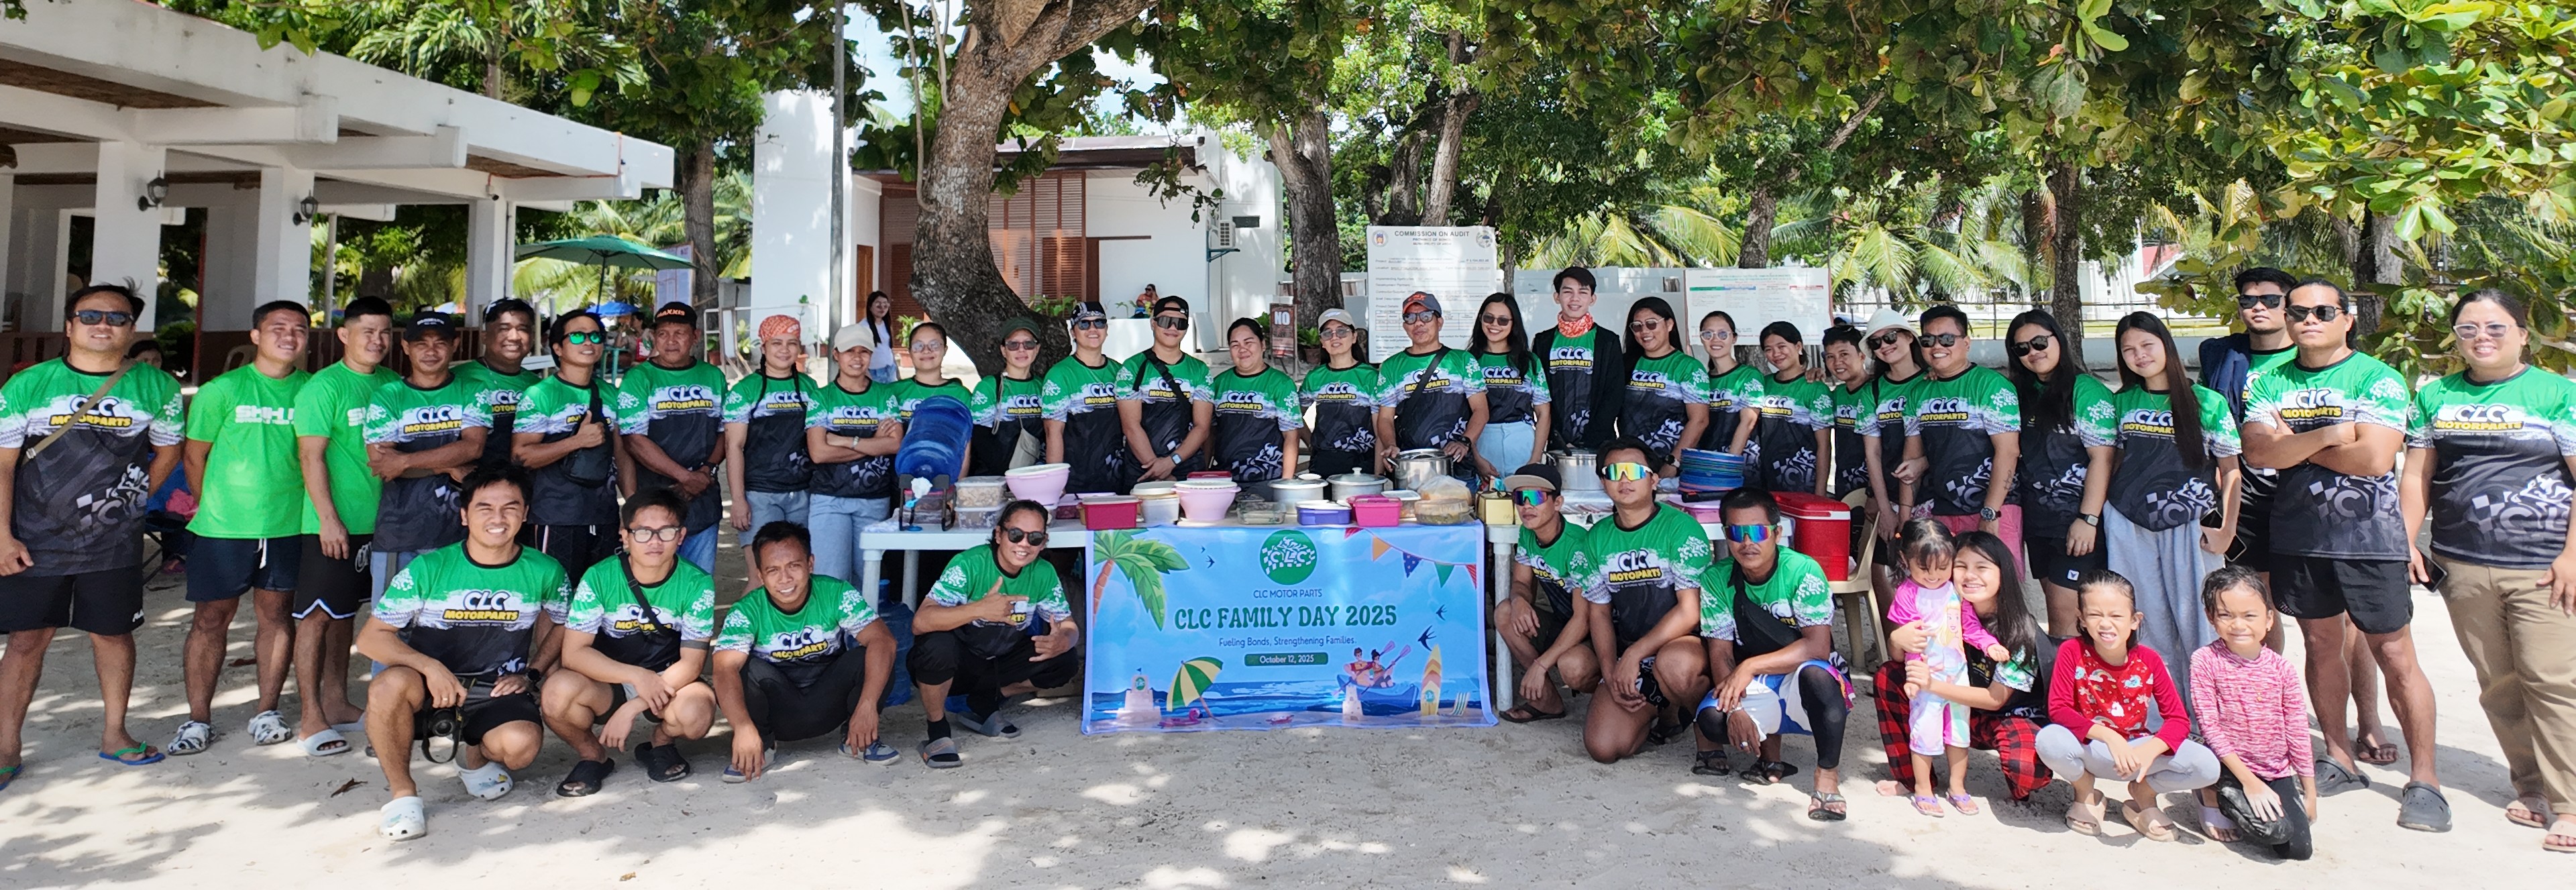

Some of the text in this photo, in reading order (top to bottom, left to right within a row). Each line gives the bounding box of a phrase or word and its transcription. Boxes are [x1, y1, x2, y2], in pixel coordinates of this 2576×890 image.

[1274, 311, 1290, 325] NO
[1558, 347, 1585, 359] CLC
[1483, 367, 1511, 379] CLC
[1631, 371, 1660, 382] CLC
[669, 386, 702, 402] CLC
[1090, 383, 1115, 397] CLC
[1326, 383, 1350, 394] CLC
[1015, 394, 1040, 408] CLC
[1227, 392, 1256, 403] CLC
[1764, 396, 1788, 408] CLC
[658, 400, 713, 410] MOTORPARTS
[1929, 398, 1959, 413] CLC
[417, 406, 452, 423] CLC
[843, 406, 871, 419] CLC
[2454, 404, 2510, 423] CLC
[2435, 420, 2524, 430] MOTORPARTS
[1618, 551, 1650, 571] CLC
[463, 590, 511, 611] CLC
[1252, 589, 1323, 599] CLC MOTOR PARTS
[443, 609, 519, 622] MOTORPARTS
[1174, 604, 1397, 630] CLC FAMILY DAY 2025
[777, 627, 814, 649] CLC
[1219, 635, 1358, 649] Fueling Bonds, Strengthening Families.
[1259, 655, 1315, 664] October 12, 2025
